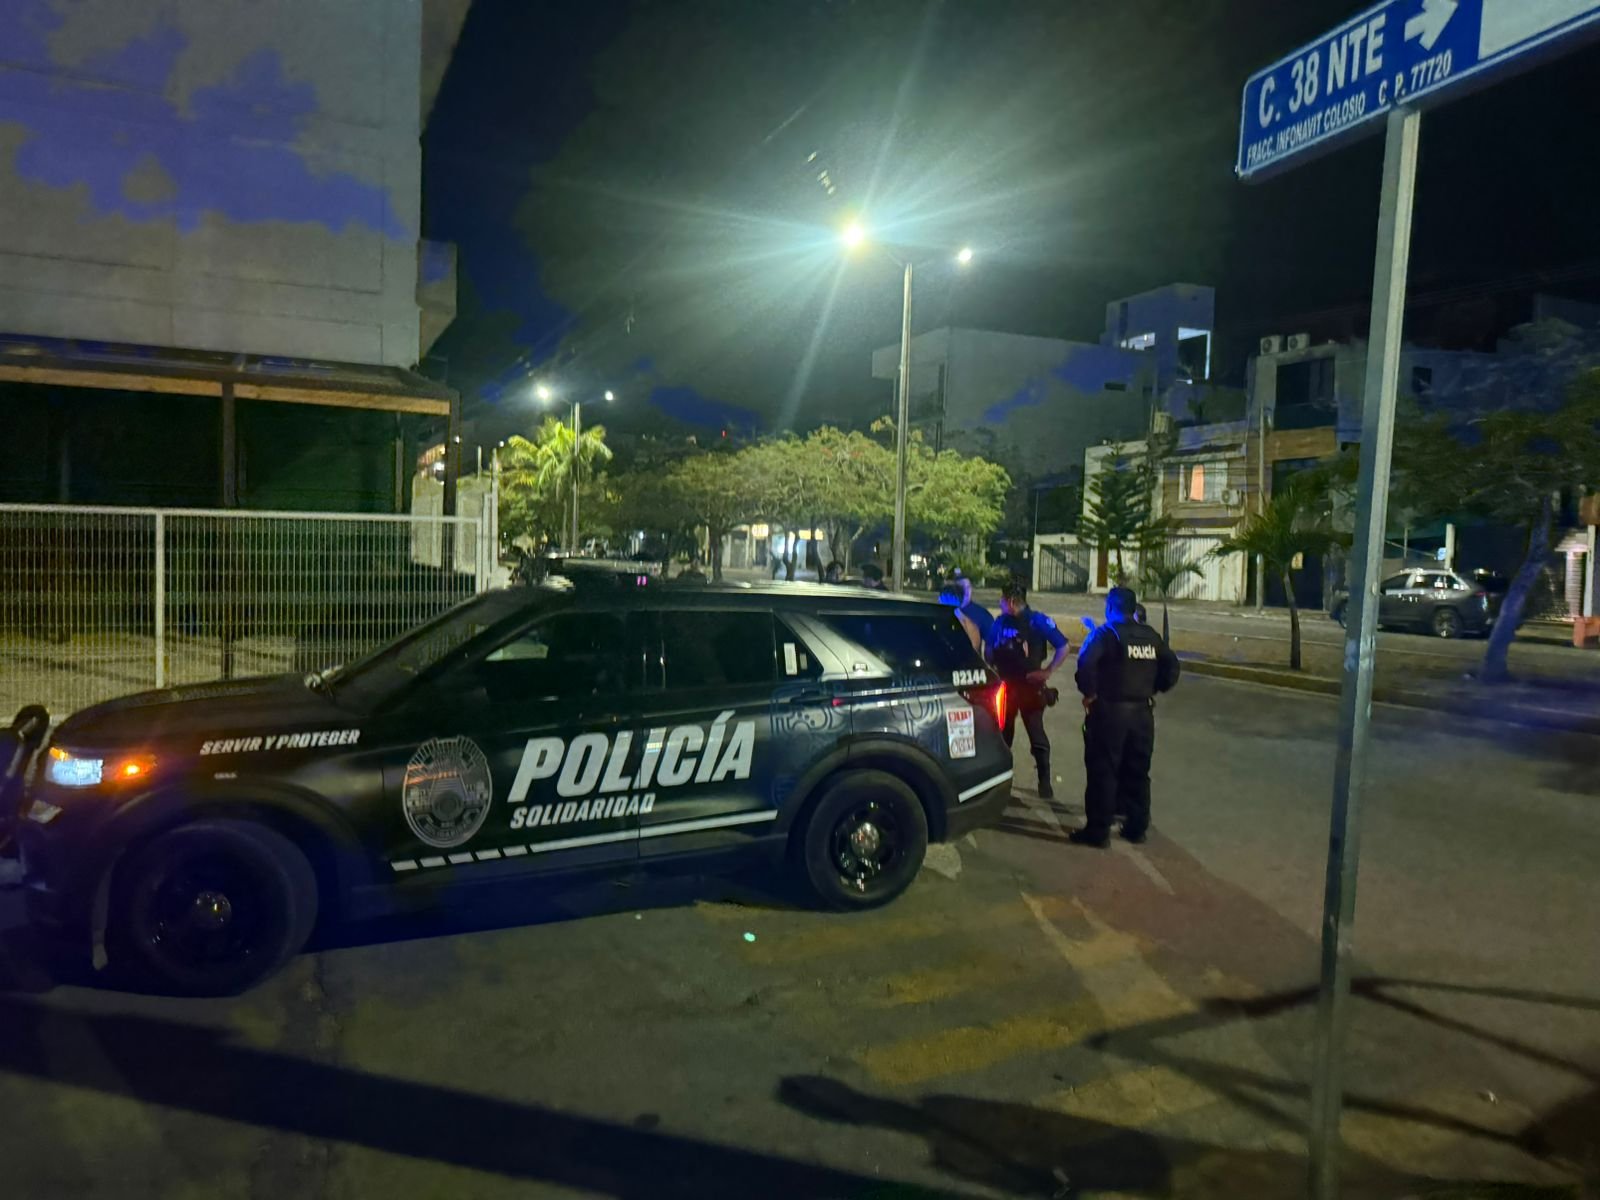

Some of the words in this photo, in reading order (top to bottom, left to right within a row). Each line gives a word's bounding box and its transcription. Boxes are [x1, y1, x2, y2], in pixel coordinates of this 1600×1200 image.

[1259, 76, 1281, 129] C.
[1288, 51, 1320, 114] 38
[1327, 12, 1386, 96] NTE
[1246, 136, 1275, 169] FRACC.
[1276, 112, 1322, 152] INFONAVIT
[1323, 91, 1366, 131] COLOSIO
[1410, 51, 1452, 91] 77720
[1127, 644, 1157, 660] POLICÍA
[200, 736, 263, 756] SERVIR
[264, 735, 276, 750] Y
[275, 728, 361, 750] PROTEGER
[507, 710, 756, 803] POLICÍA
[510, 792, 656, 829] SOLIDARIDAD
